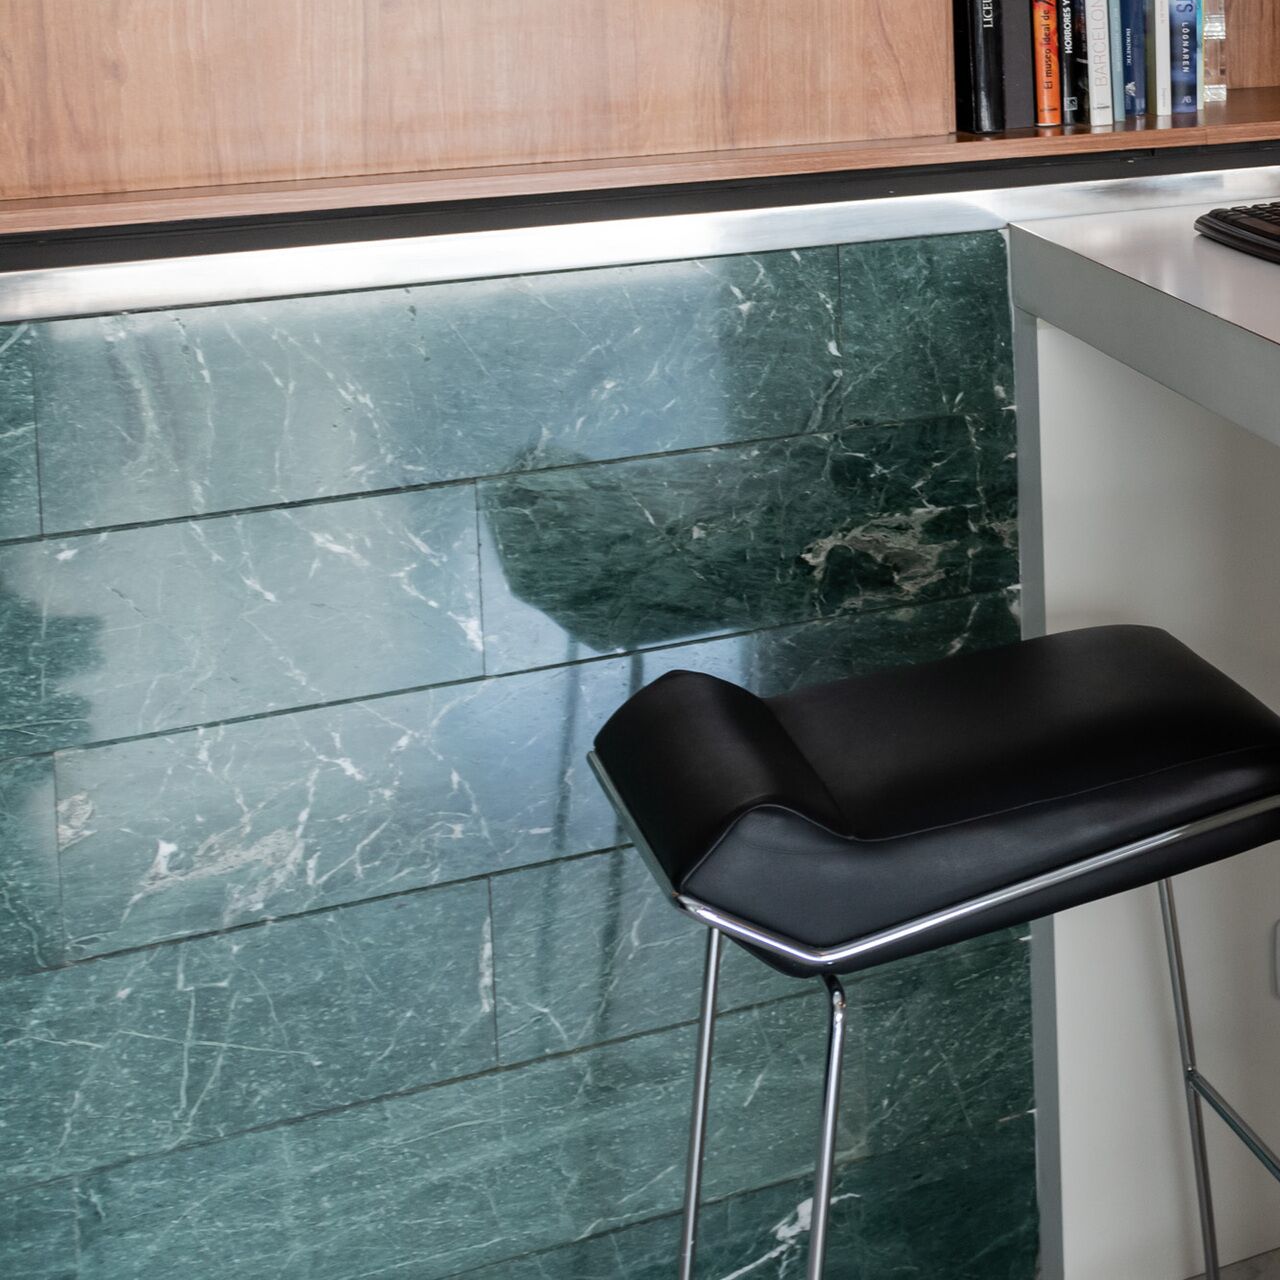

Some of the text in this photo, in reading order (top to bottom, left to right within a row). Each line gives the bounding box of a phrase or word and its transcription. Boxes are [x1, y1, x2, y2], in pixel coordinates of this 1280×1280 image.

[1041, 8, 1050, 21] de
[1041, 21, 1052, 47] ideal
[1063, 6, 1074, 54] HORRORES
[1042, 47, 1054, 78] museo
